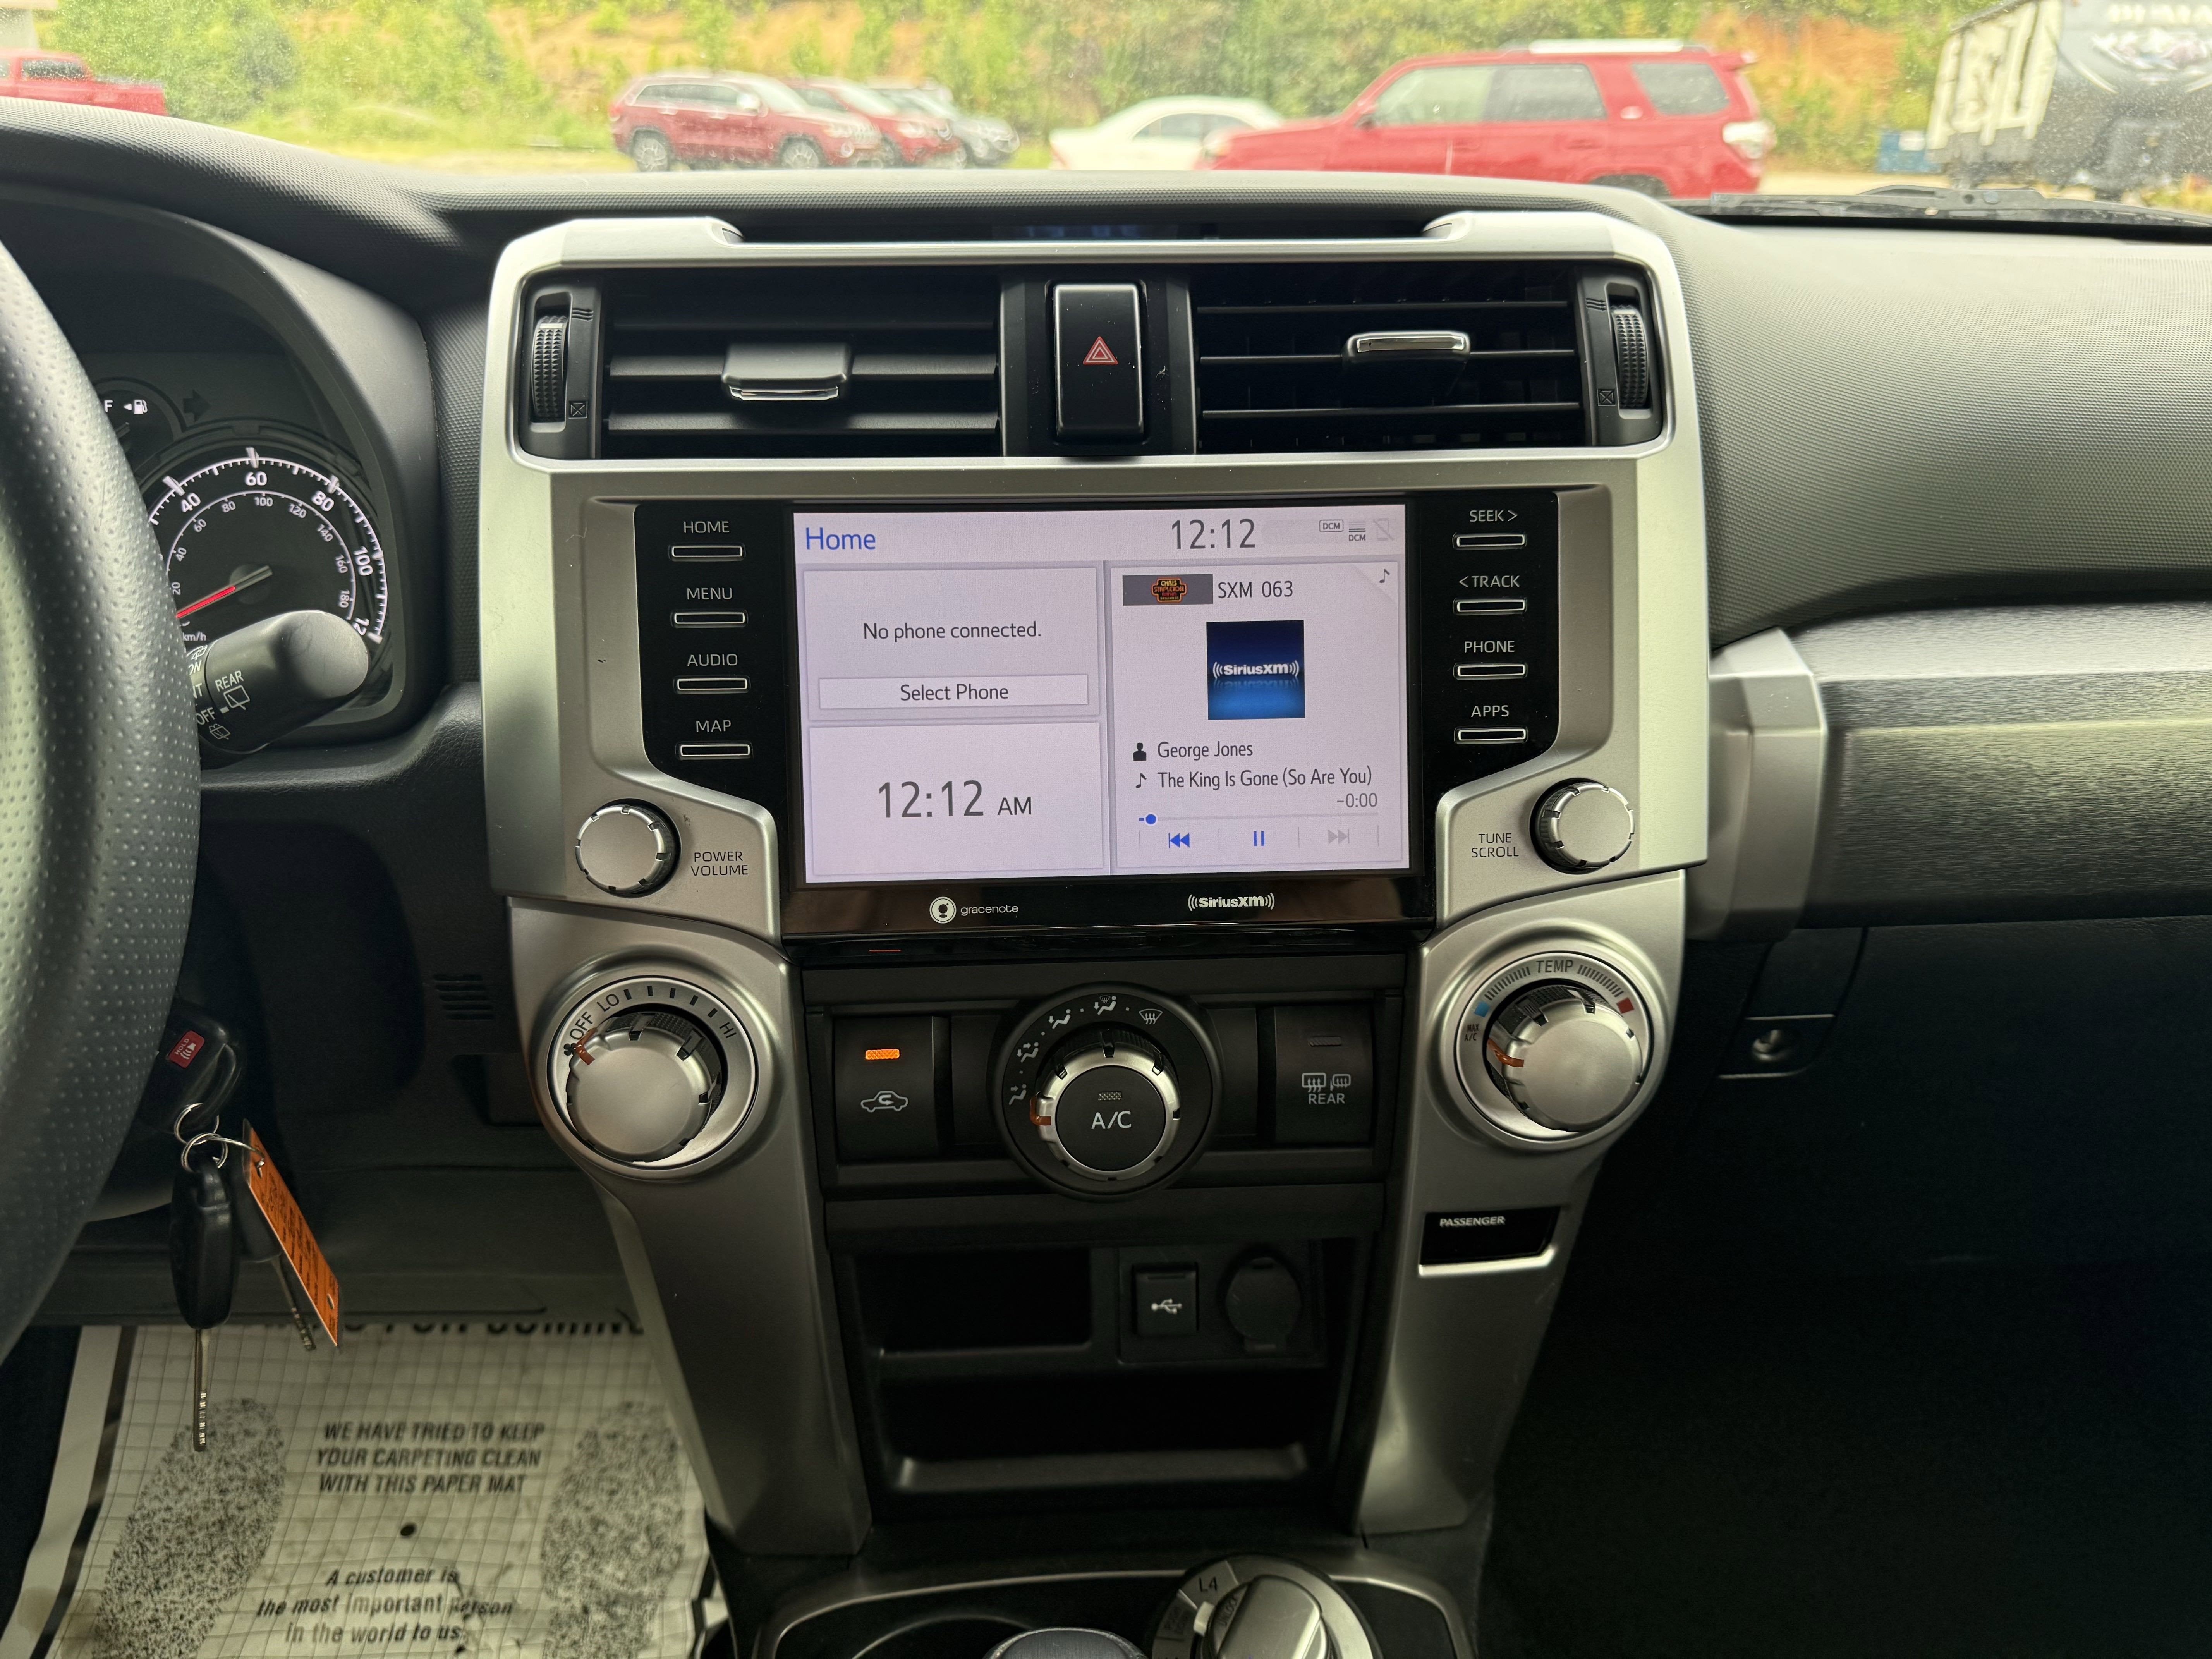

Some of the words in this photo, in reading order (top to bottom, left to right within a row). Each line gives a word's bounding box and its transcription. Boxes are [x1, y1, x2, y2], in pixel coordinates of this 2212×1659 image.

[105, 400, 113, 412] F
[245, 472, 267, 486] 60
[181, 493, 201, 513] 40
[221, 501, 236, 513] 80
[254, 497, 273, 507] 100
[312, 490, 334, 512] 80
[289, 504, 307, 518] 120
[1469, 510, 1504, 522] SEEK
[194, 519, 206, 532] 60
[317, 524, 333, 542] 140
[684, 521, 730, 533] HOME
[806, 527, 876, 550] Home
[1171, 519, 1256, 550] 12:12
[176, 547, 187, 561] 40
[353, 546, 373, 576] 100
[335, 554, 348, 573] 160
[172, 582, 180, 595] 20
[1218, 582, 1252, 598] SXM
[1262, 580, 1293, 598] 063
[1472, 575, 1520, 587] TRACK
[339, 590, 350, 608] 180
[687, 588, 732, 600] MENU
[352, 617, 369, 635] 12
[864, 623, 888, 639] No
[895, 622, 945, 642] phone
[951, 621, 1042, 638] connected.
[183, 631, 207, 641] km/h
[1464, 641, 1515, 653] PHONE
[687, 654, 738, 666] AUDIO
[215, 670, 244, 692] REAR
[900, 684, 951, 701] Select
[957, 684, 1009, 699] Phone
[196, 707, 215, 725] OFF
[1471, 705, 1509, 717] APPS
[696, 720, 731, 732] MAP
[1158, 742, 1209, 761] George
[1214, 741, 1253, 757] Jones
[1158, 771, 1184, 788] The
[1189, 771, 1220, 790] King
[1225, 771, 1236, 787] Is
[1240, 770, 1278, 786] Gone
[1283, 767, 1306, 788] (So
[1310, 769, 1335, 785] Are
[1340, 766, 1372, 786] You)
[879, 780, 984, 818] 12:12
[997, 797, 1032, 816] AM
[1478, 833, 1512, 844] TUNE
[694, 851, 744, 862] POWER
[1472, 847, 1519, 858] SCROLL
[691, 865, 749, 876] VOLUME
[960, 904, 1018, 916] gracenote
[1536, 960, 1574, 974] TEMP
[597, 993, 620, 1012] LO
[569, 1011, 593, 1041] OFF
[719, 1022, 737, 1039] HI
[1467, 1024, 1479, 1032] MAX
[1465, 1033, 1477, 1041] A/C
[175, 1038, 189, 1055] HOLD
[1308, 1093, 1345, 1105] REAR
[1091, 1110, 1132, 1130] A/C
[1440, 1216, 1506, 1227] PASSENGER
[325, 1422, 353, 1441] WE
[358, 1422, 405, 1441] HAVE
[412, 1421, 464, 1441] TRIED
[471, 1422, 494, 1440] TO
[501, 1422, 545, 1441] KEEP
[317, 1448, 368, 1467] YOUR
[373, 1448, 477, 1467] CARPETING
[482, 1448, 542, 1467] CLEAN
[320, 1474, 368, 1493] WITH
[376, 1475, 416, 1493] THIS
[423, 1475, 481, 1493] PAPER
[489, 1475, 526, 1493] MAT
[326, 1569, 338, 1586] A
[345, 1566, 434, 1585] customer
[442, 1566, 460, 1584] is
[1199, 1577, 1218, 1592] L4
[257, 1599, 286, 1617] the
[293, 1595, 338, 1616] most
[346, 1594, 443, 1617] important
[451, 1597, 513, 1619] person
[286, 1622, 304, 1642] in
[313, 1622, 343, 1643] the
[352, 1623, 406, 1643] world
[412, 1622, 429, 1640] to
